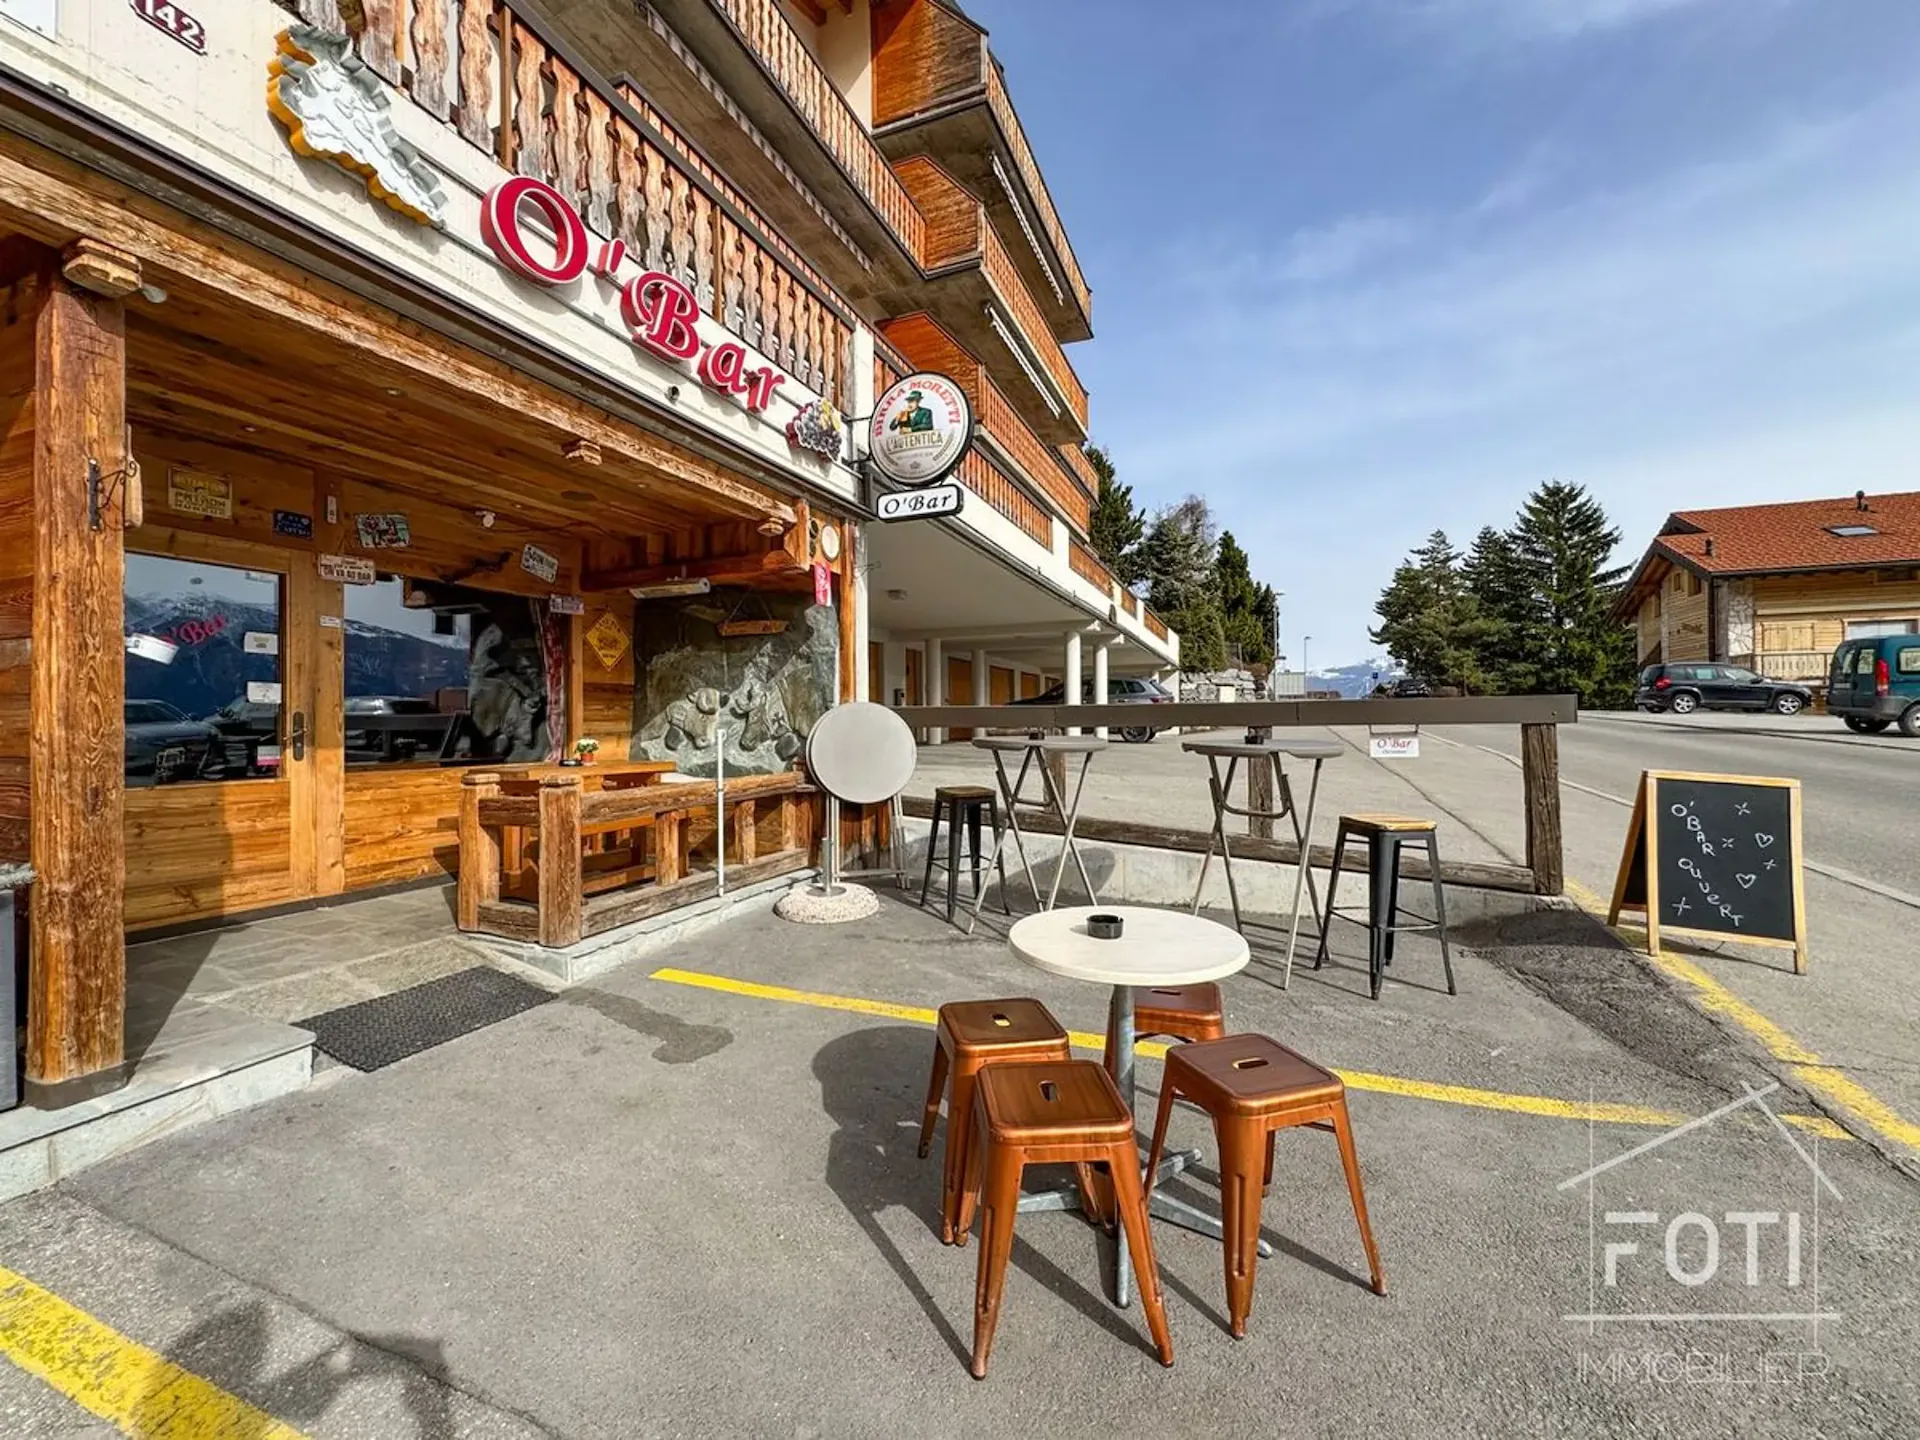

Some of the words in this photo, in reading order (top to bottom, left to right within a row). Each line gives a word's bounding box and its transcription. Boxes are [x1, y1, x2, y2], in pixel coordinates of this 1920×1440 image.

[144, 0, 201, 47] 142
[480, 176, 785, 414] O'Bar
[872, 386, 906, 438] BIRRA
[909, 378, 961, 425] MORETTI
[886, 430, 943, 452] L'AUTENTICA
[883, 493, 952, 515] O'Bar
